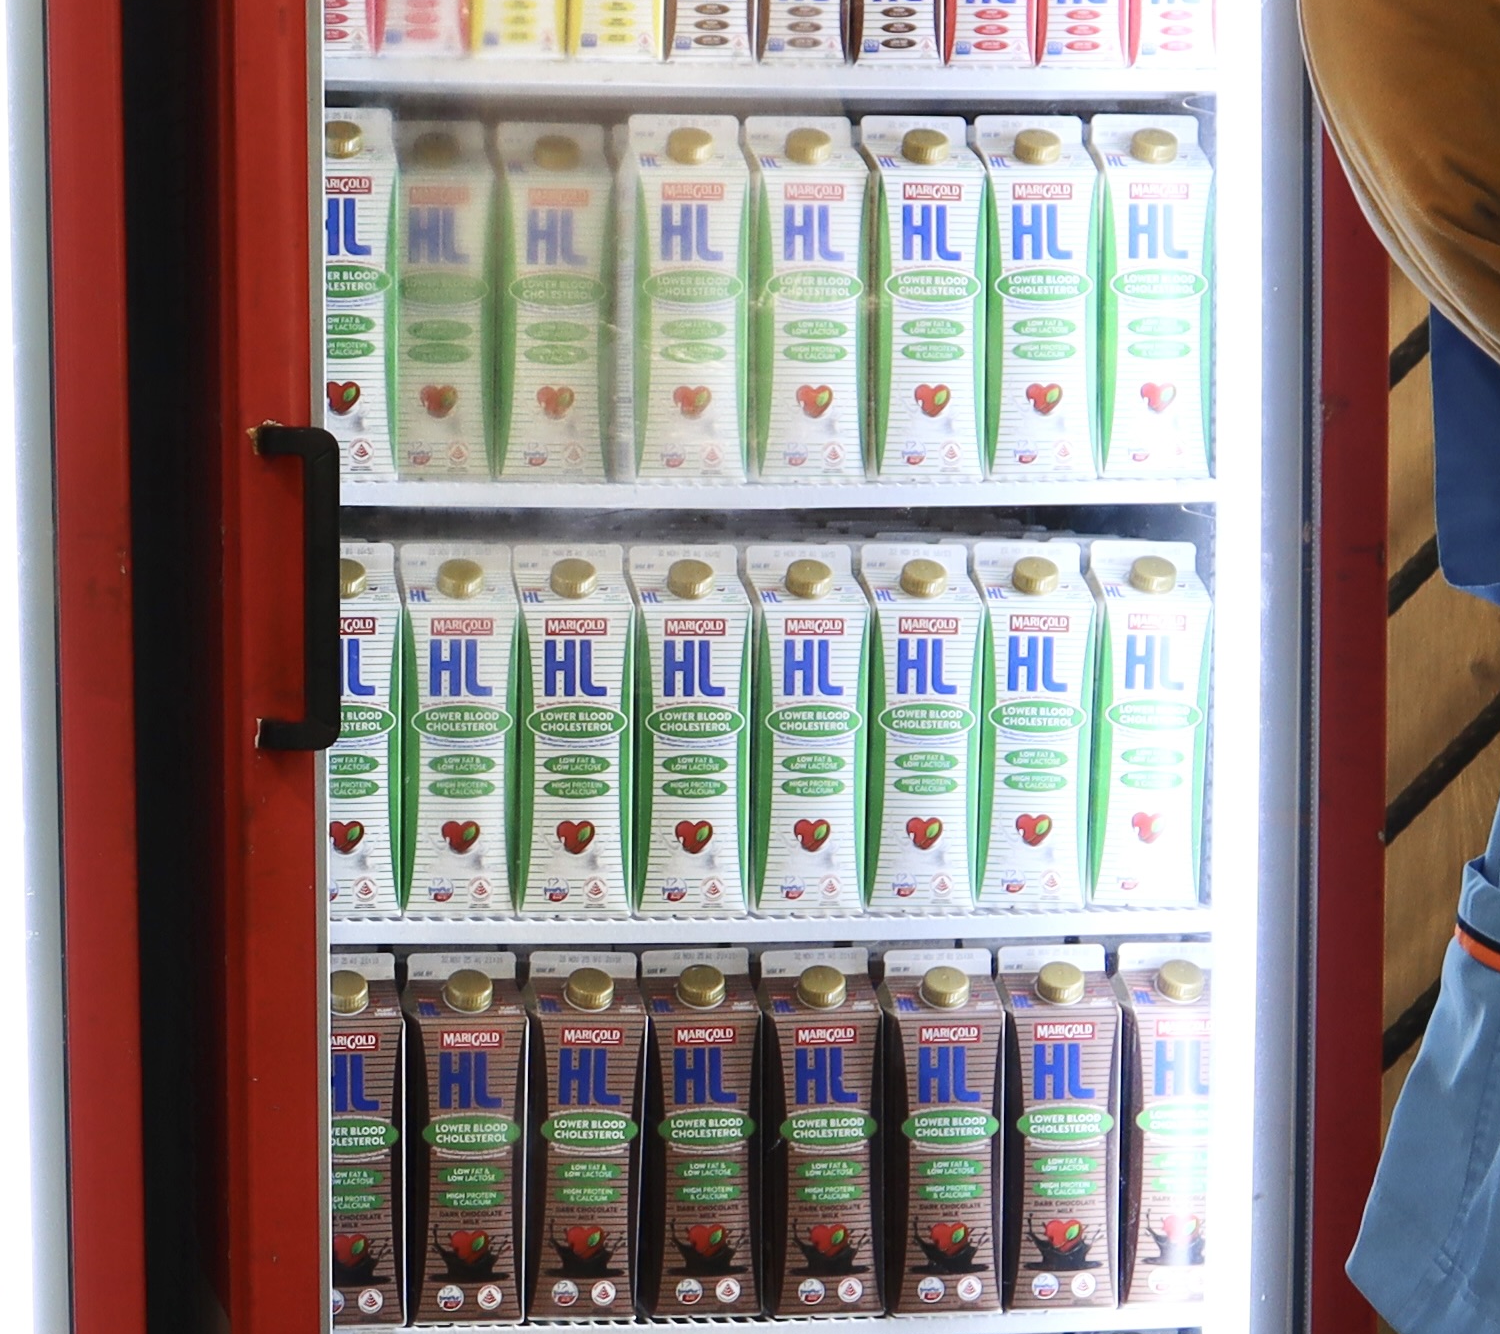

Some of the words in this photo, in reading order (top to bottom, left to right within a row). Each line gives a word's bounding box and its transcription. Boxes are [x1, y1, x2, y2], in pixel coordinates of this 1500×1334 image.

[904, 184, 960, 199] MARIGOLD
[1014, 184, 1071, 199] MARIGOLD
[782, 204, 846, 263] HL
[899, 202, 963, 263] HL
[1010, 202, 1074, 262] HL
[898, 275, 933, 286] LOWER
[934, 275, 969, 286] BLOOD
[898, 285, 969, 296] CHOLESTEROL
[548, 620, 606, 634] MARIGOLD
[667, 620, 724, 635] MARIGOLD
[428, 638, 494, 698] HL
[543, 638, 609, 698] HL
[662, 639, 727, 698] HL
[781, 637, 845, 698] HL
[893, 636, 958, 697] HL
[1005, 634, 1069, 694] HL
[540, 712, 577, 721] LOWER
[578, 712, 614, 721] BLOOD
[540, 721, 614, 732] CHOLESTEROL
[563, 1029, 621, 1044] MARIGOLD
[677, 1028, 734, 1043] MARIGOLD
[921, 1026, 979, 1042] MARIGOLD
[1036, 1024, 1093, 1039] MARIGOLD
[439, 1053, 501, 1108] HL
[559, 1048, 621, 1106] HL
[674, 1047, 737, 1104] HL
[795, 1047, 859, 1105] HL
[917, 1045, 982, 1104] HL
[1031, 1041, 1097, 1101] HL
[553, 1119, 590, 1129] LOWER
[591, 1119, 626, 1129] BLOOD
[554, 1130, 625, 1140] CHOLESTEROL
